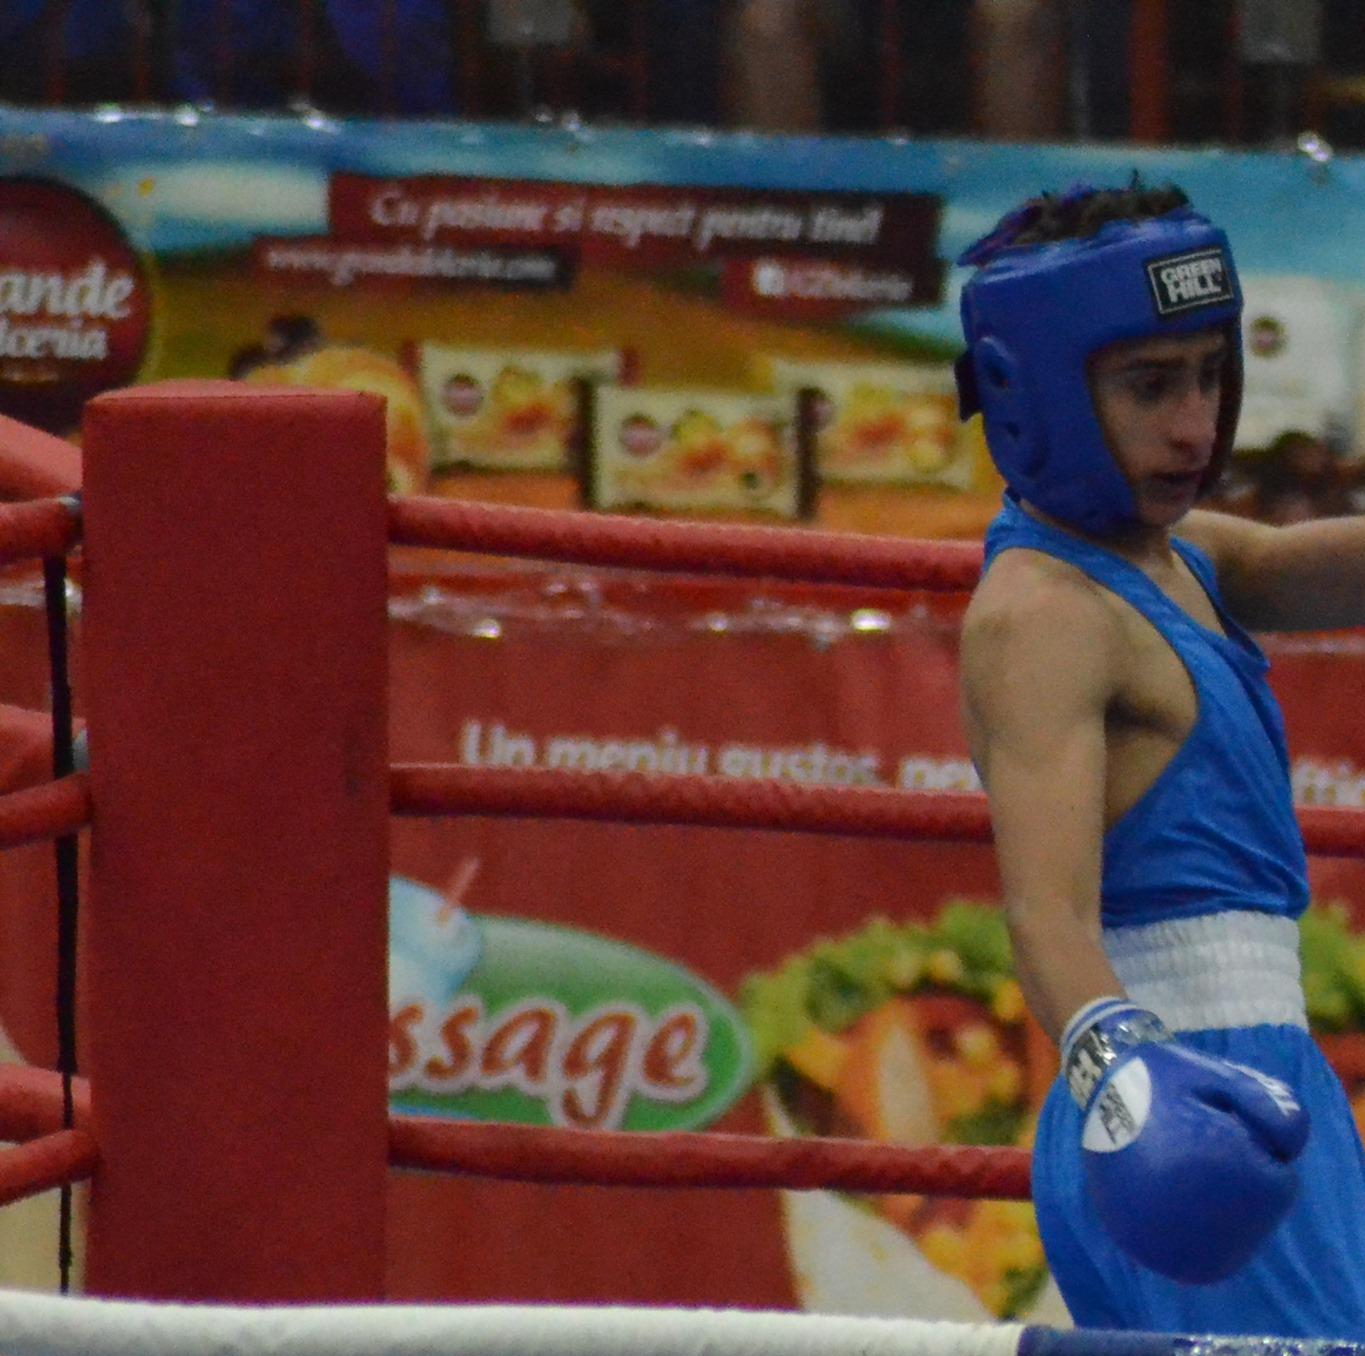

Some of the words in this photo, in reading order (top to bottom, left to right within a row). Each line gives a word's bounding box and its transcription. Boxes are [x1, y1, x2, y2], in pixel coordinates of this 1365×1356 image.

[1160, 257, 1222, 285] GREEN
[1167, 272, 1222, 304] HILL
[460, 720, 536, 768] Un
